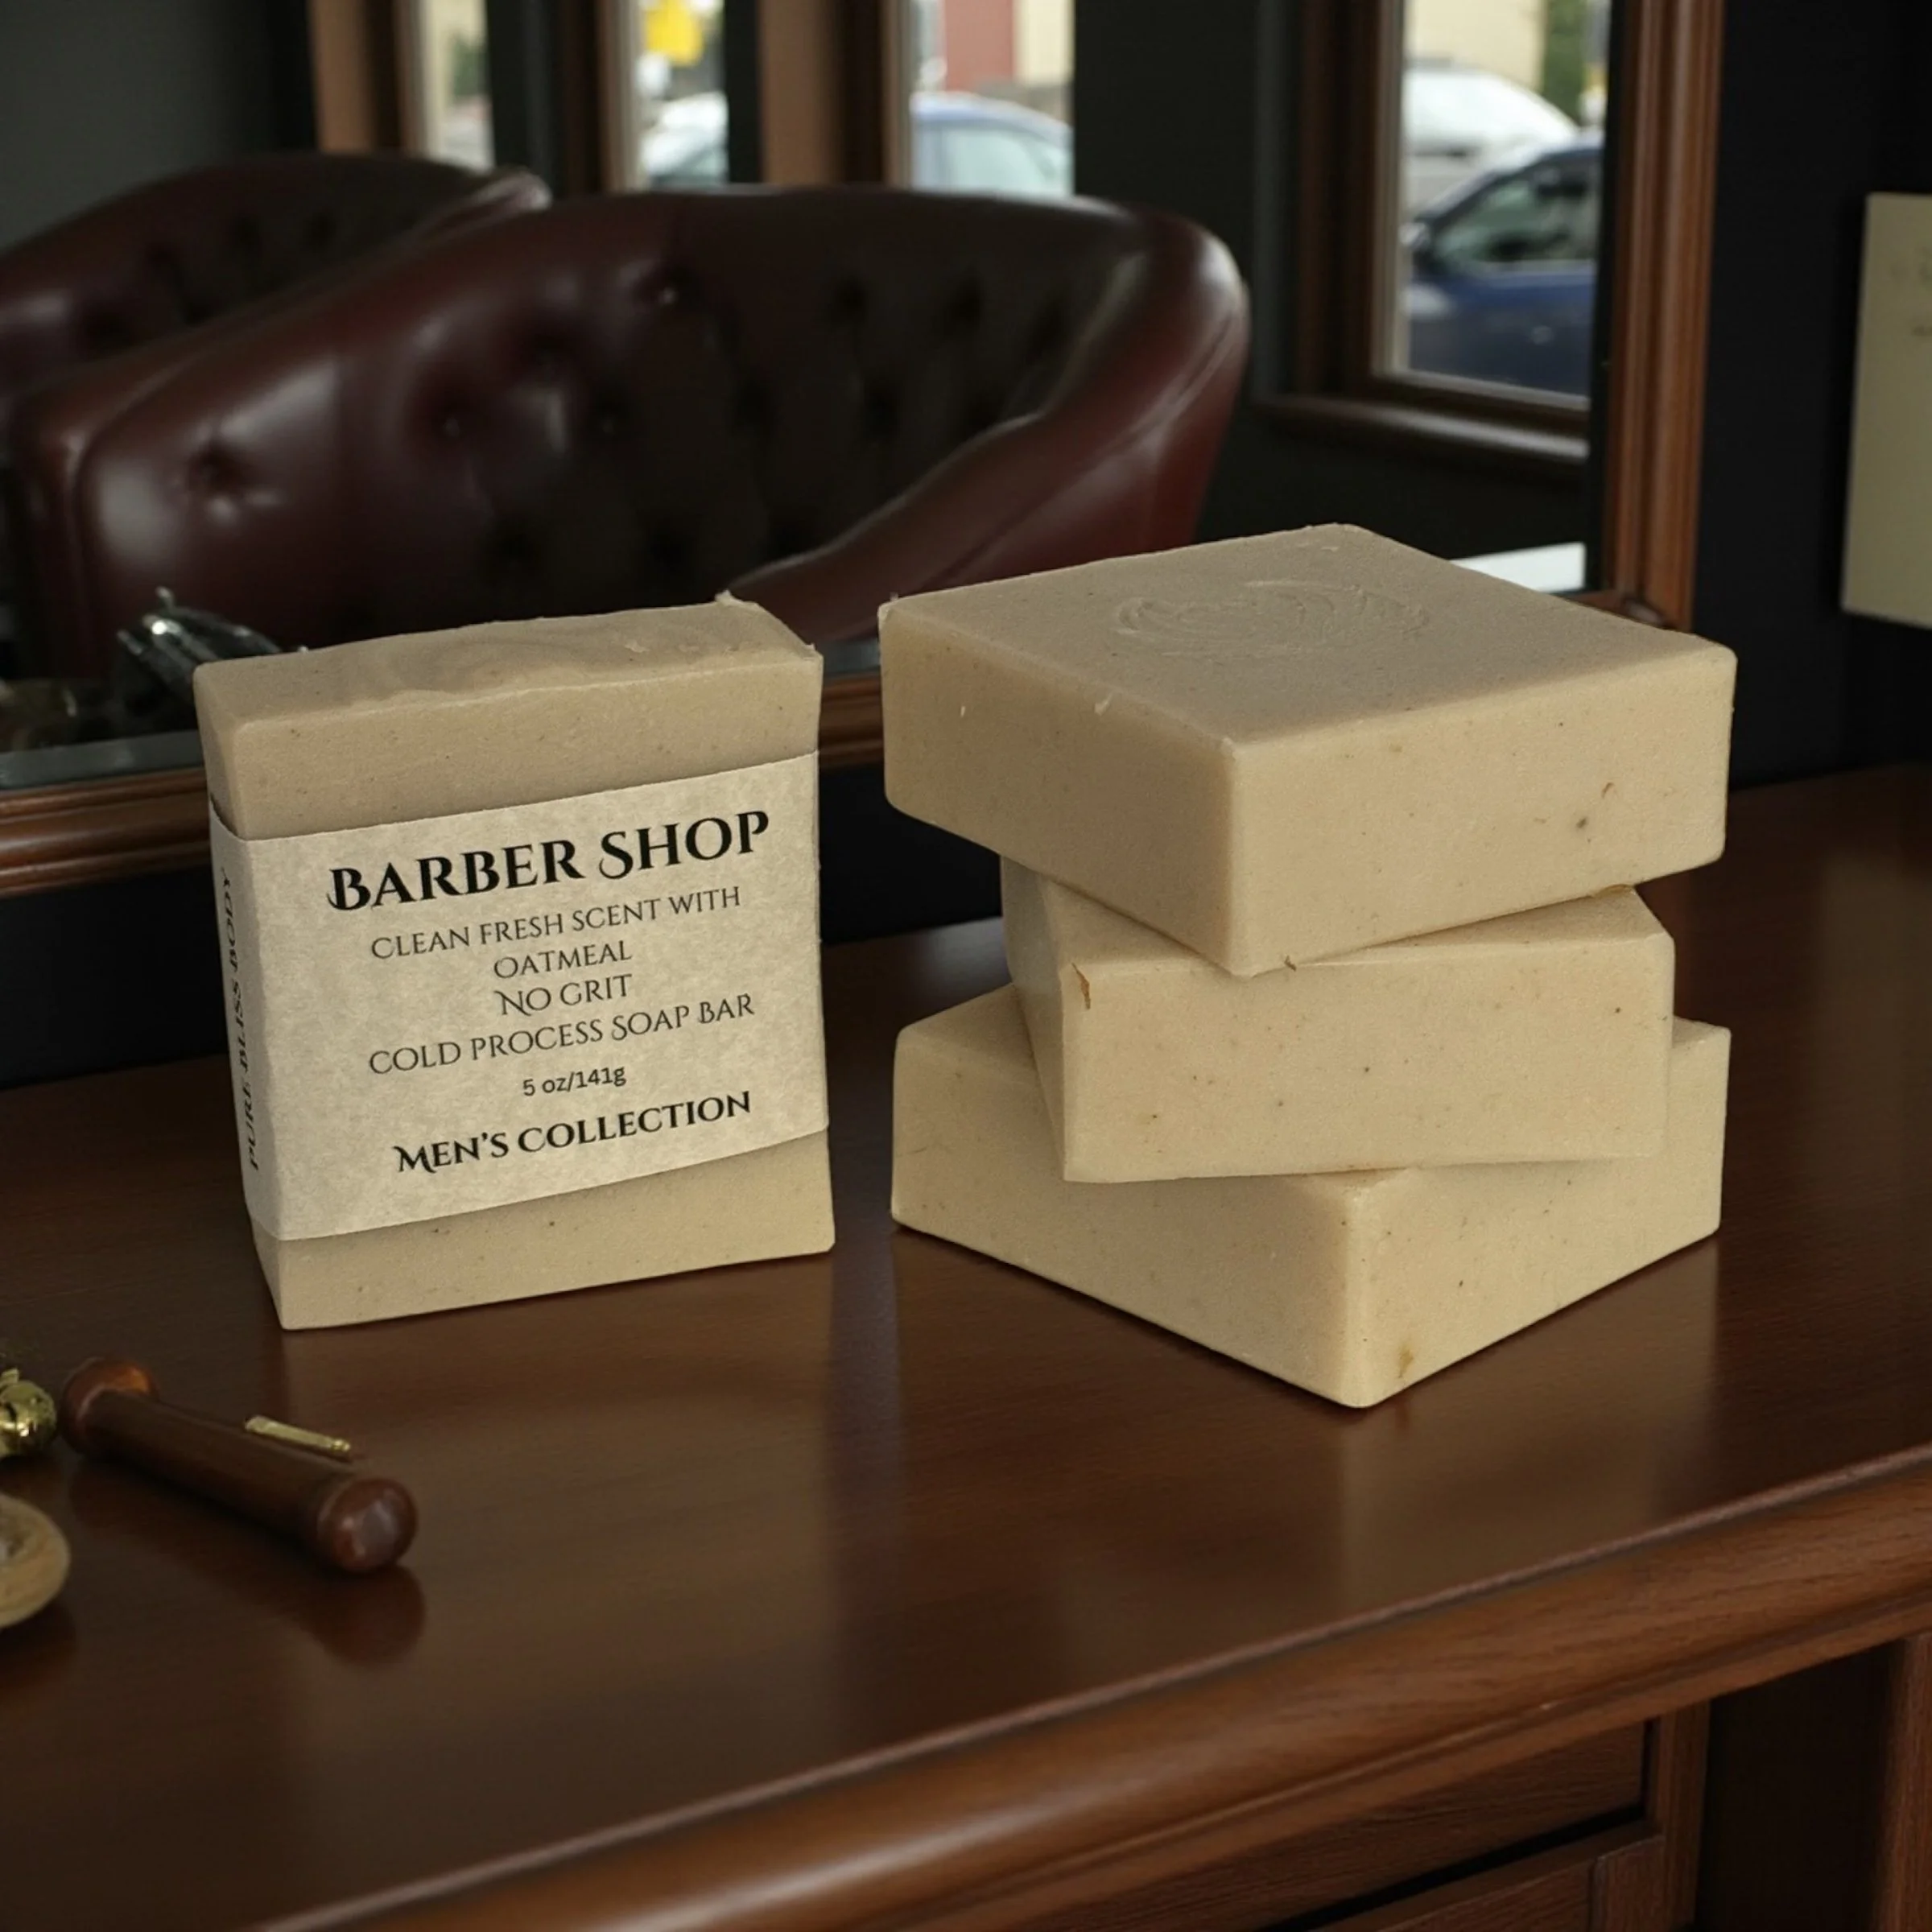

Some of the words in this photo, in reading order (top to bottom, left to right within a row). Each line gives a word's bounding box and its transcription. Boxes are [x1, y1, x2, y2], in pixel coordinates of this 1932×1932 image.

[326, 840, 586, 910] BARBER
[598, 811, 769, 880] SHOP
[221, 869, 238, 972] BODY
[371, 927, 469, 960] CLEAN
[480, 914, 564, 944] FRESH
[572, 898, 661, 931] SCENT
[668, 886, 740, 914] WITH
[493, 940, 632, 979] OATMEAL
[231, 980, 248, 1072] BLISS
[369, 1042, 461, 1074] COLD
[470, 1019, 603, 1060] PROCESS
[611, 1005, 689, 1041] SOAP
[698, 993, 754, 1024] BAR
[493, 988, 551, 1017] NO
[559, 973, 632, 1005] GRIT
[522, 1079, 535, 1096] 5
[542, 1067, 626, 1093] oz/141g
[242, 1078, 258, 1171] PURE
[392, 1132, 509, 1174] MEN'S
[518, 1091, 750, 1153] COLLECTION
